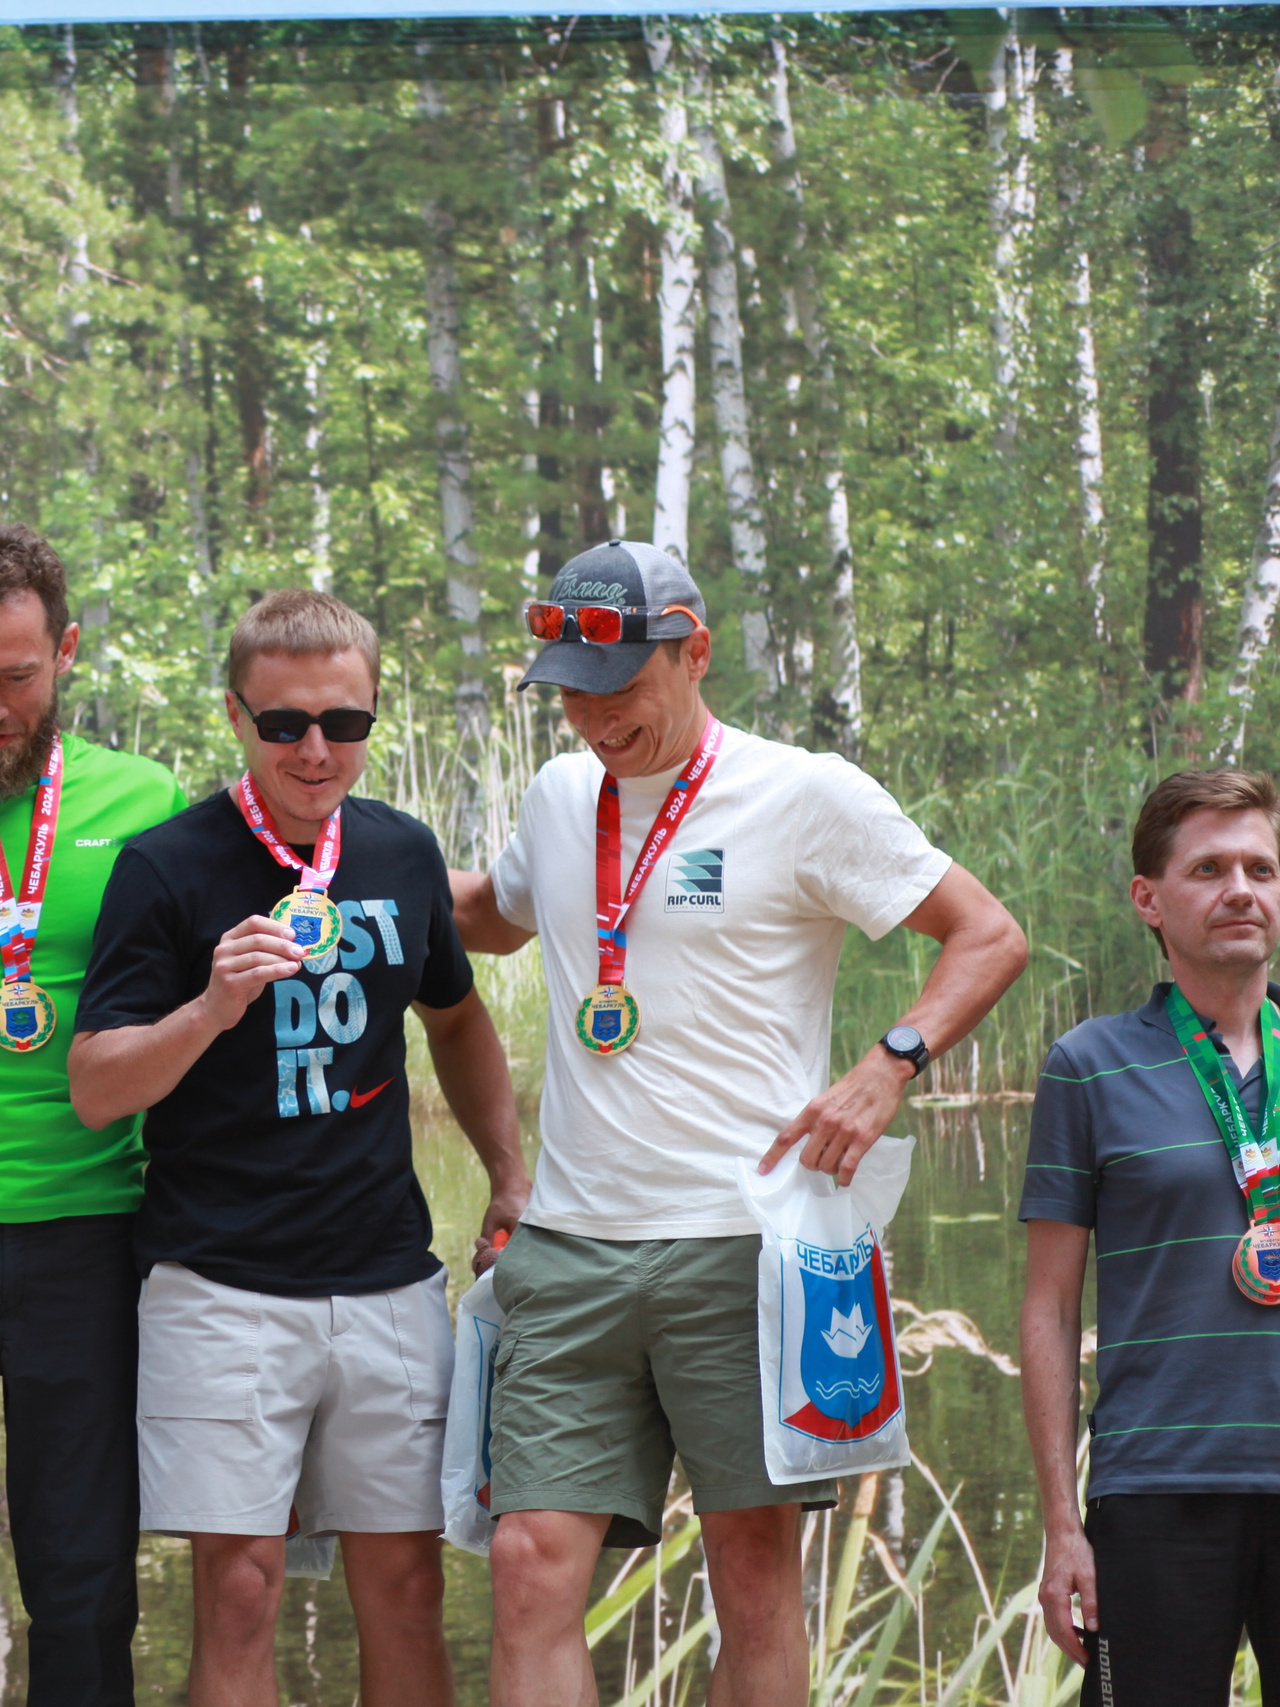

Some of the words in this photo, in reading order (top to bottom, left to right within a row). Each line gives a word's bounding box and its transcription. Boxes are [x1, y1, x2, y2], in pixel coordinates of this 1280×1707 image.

[28, 823, 49, 895] ЧЕБАРКУЛЬ
[41, 786, 55, 816] 2024
[75, 838, 112, 848] CRAFT
[628, 827, 668, 897] ЧЕБАРКУЛЬ
[666, 790, 688, 822] 2024
[667, 895, 688, 906] RIP
[688, 894, 722, 906] CURL
[273, 972, 368, 1049] DO
[276, 1046, 351, 1119] IT.
